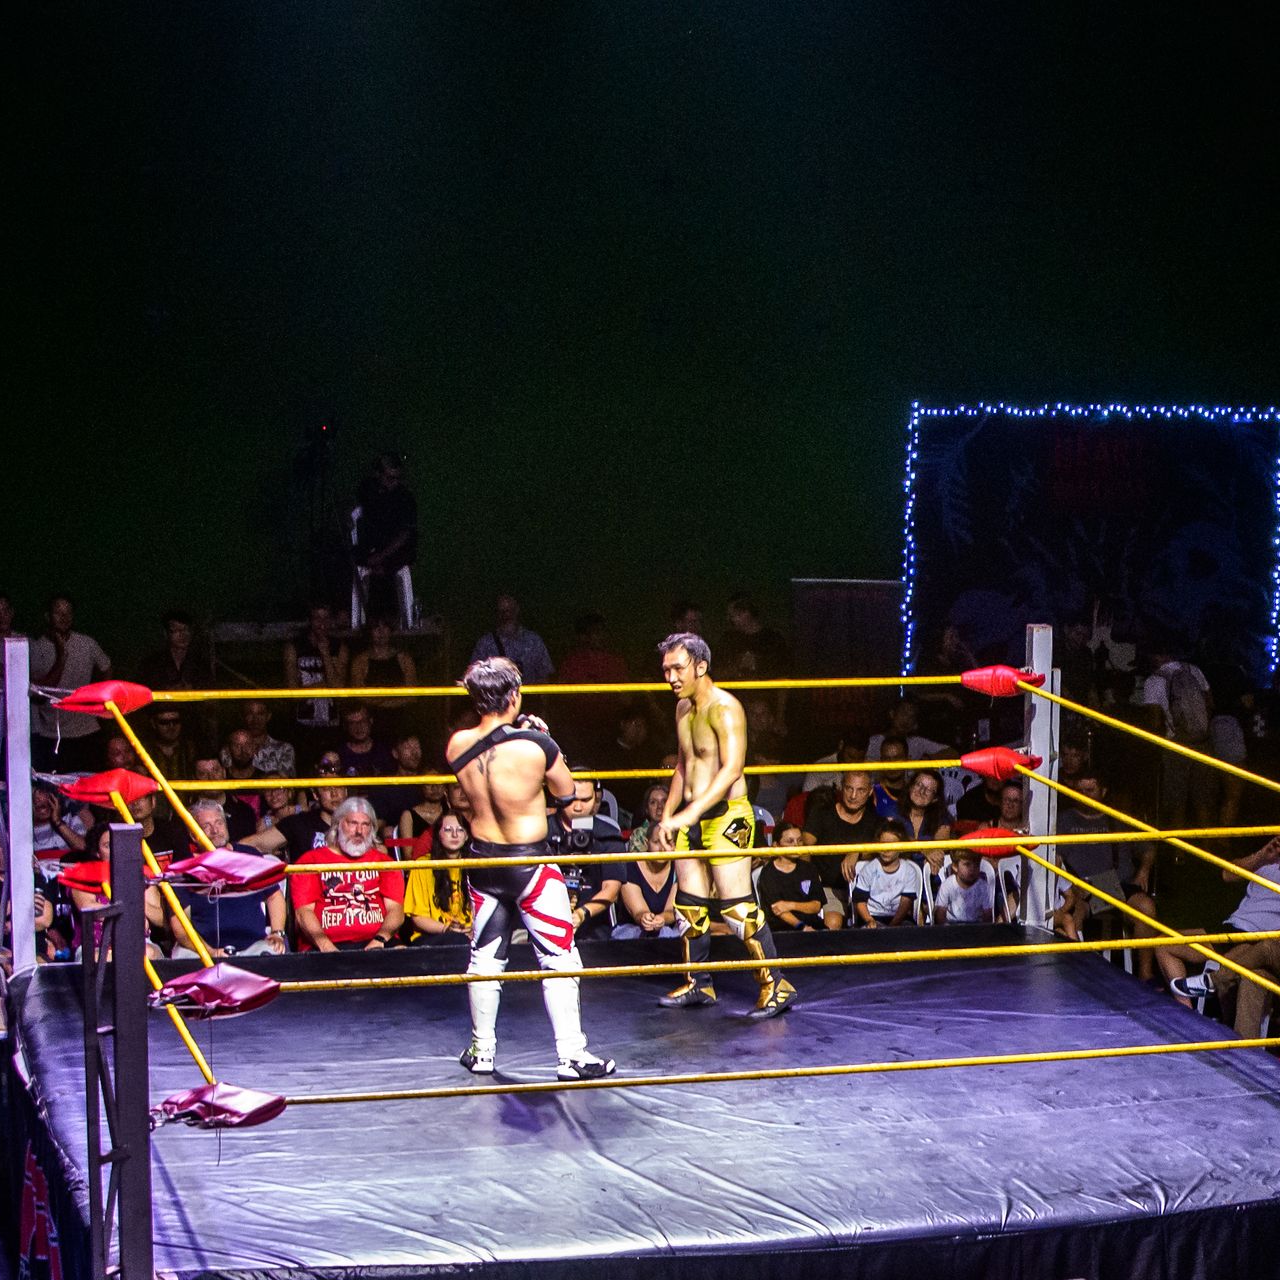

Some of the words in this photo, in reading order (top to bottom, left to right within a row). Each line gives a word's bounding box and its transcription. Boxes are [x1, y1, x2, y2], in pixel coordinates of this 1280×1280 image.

[321, 870, 352, 884] DONT
[322, 910, 343, 929] KEEP
[345, 908, 357, 927] IT
[359, 908, 384, 925] GOING
